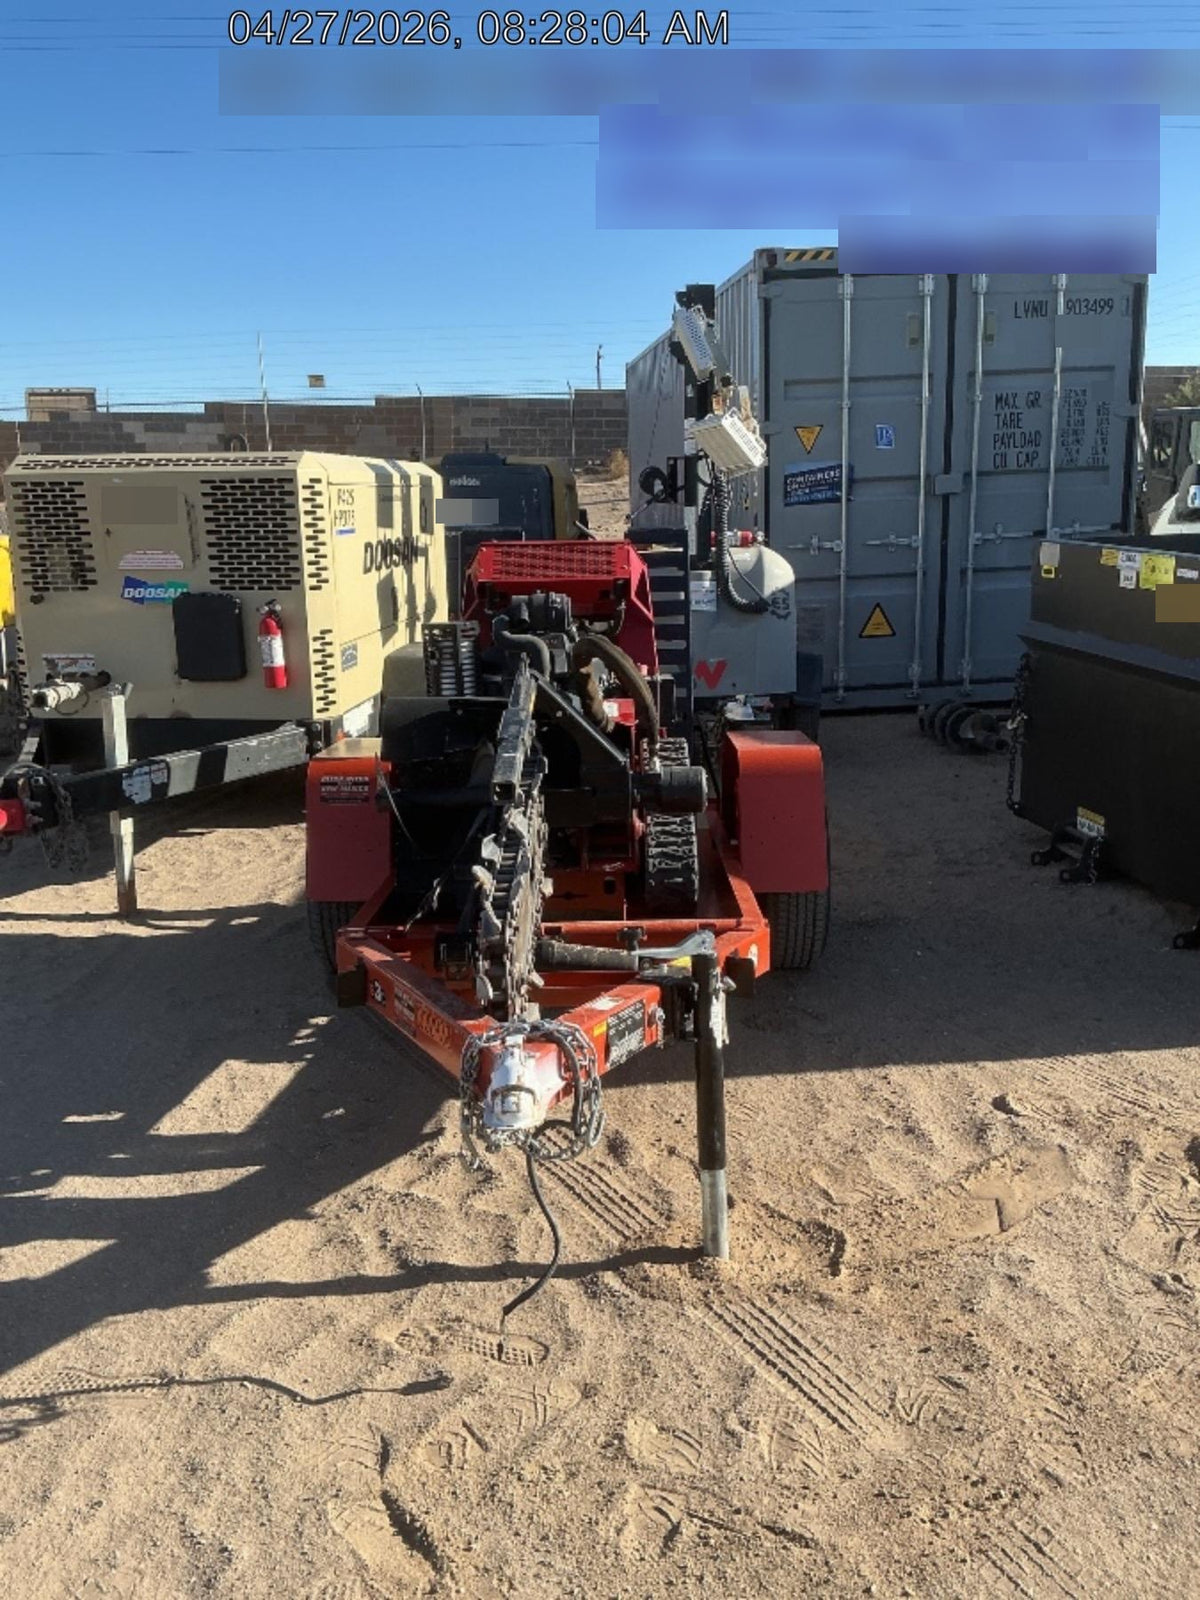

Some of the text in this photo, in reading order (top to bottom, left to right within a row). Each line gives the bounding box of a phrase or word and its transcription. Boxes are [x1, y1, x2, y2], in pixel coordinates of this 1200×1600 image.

[1066, 298, 1114, 315] 903499
[994, 411, 1024, 430] TARE
[993, 430, 1042, 450] PAYLOAD
[363, 535, 419, 575] DOOSAN
